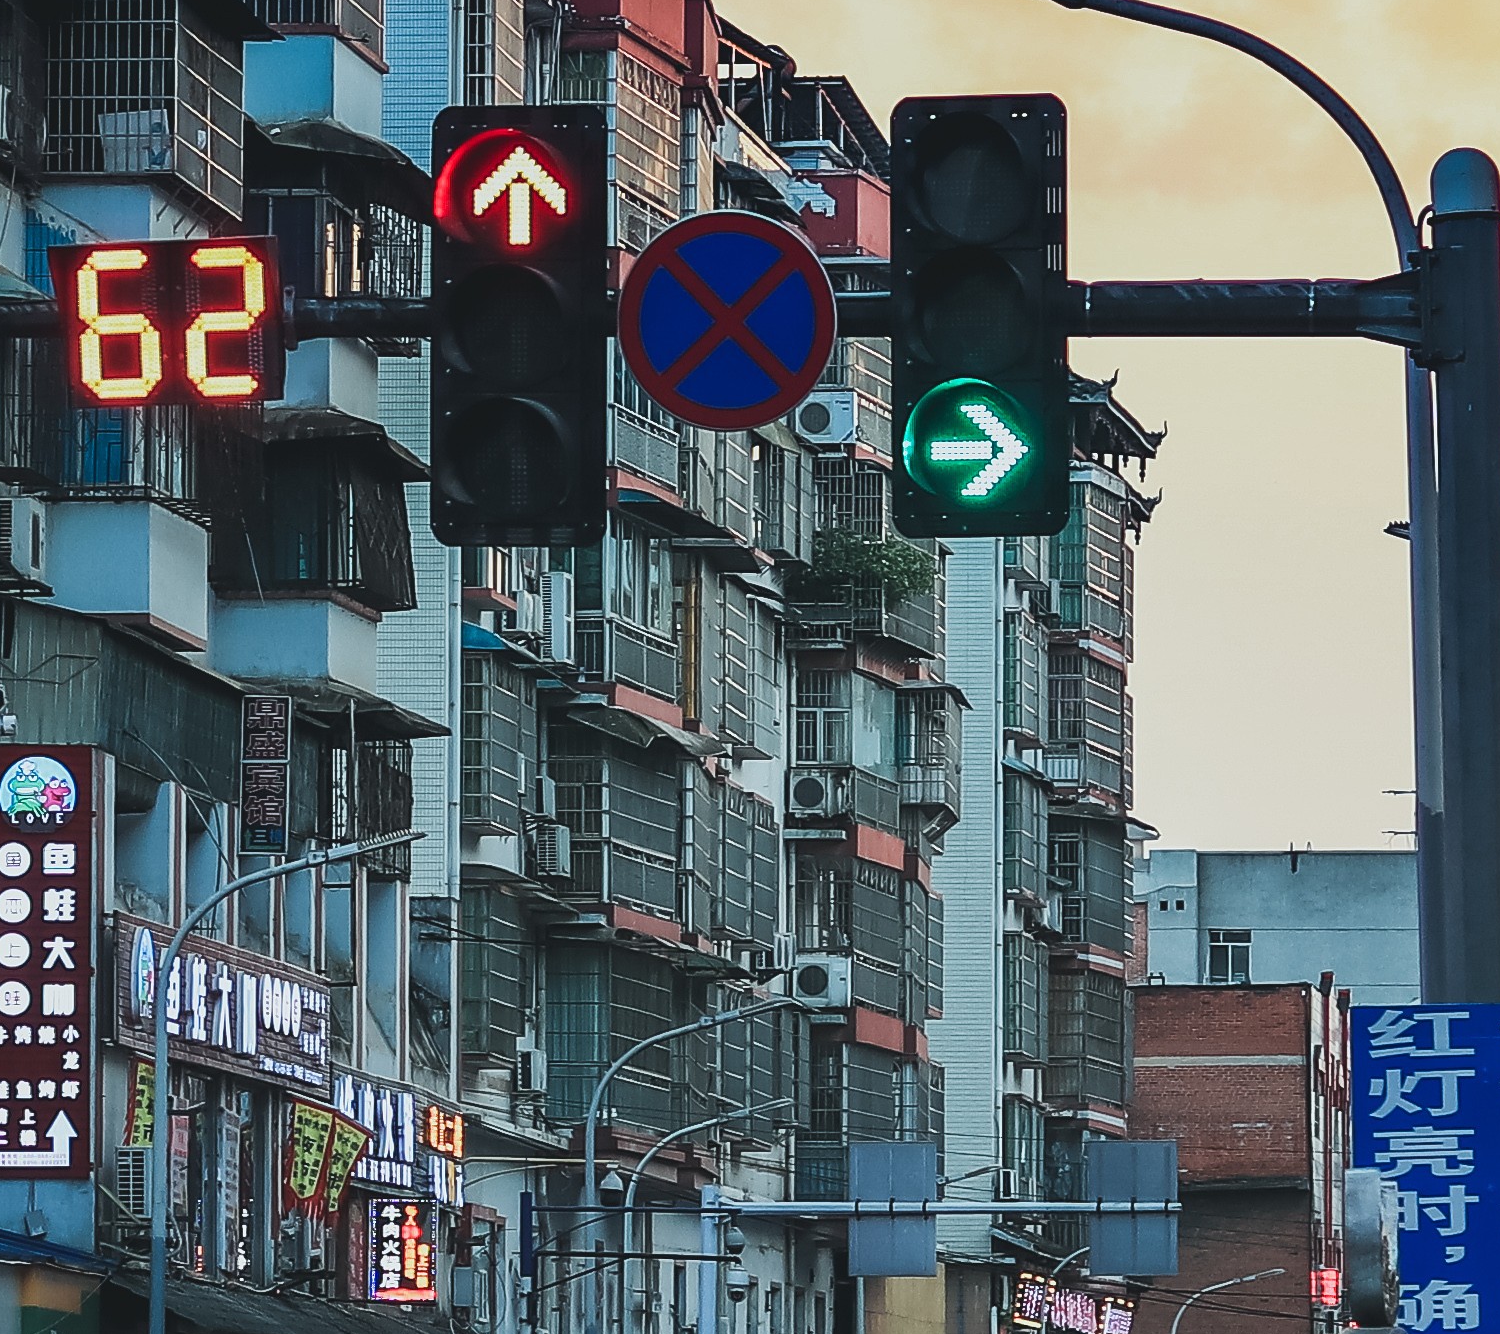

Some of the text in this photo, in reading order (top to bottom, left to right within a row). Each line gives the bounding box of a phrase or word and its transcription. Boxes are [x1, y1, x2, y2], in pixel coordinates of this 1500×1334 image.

[75, 247, 270, 404] 62
[243, 698, 285, 827] 鼎盛宾馆
[11, 812, 64, 824] LOVE
[379, 1204, 402, 1289] 牛肉火锅店
